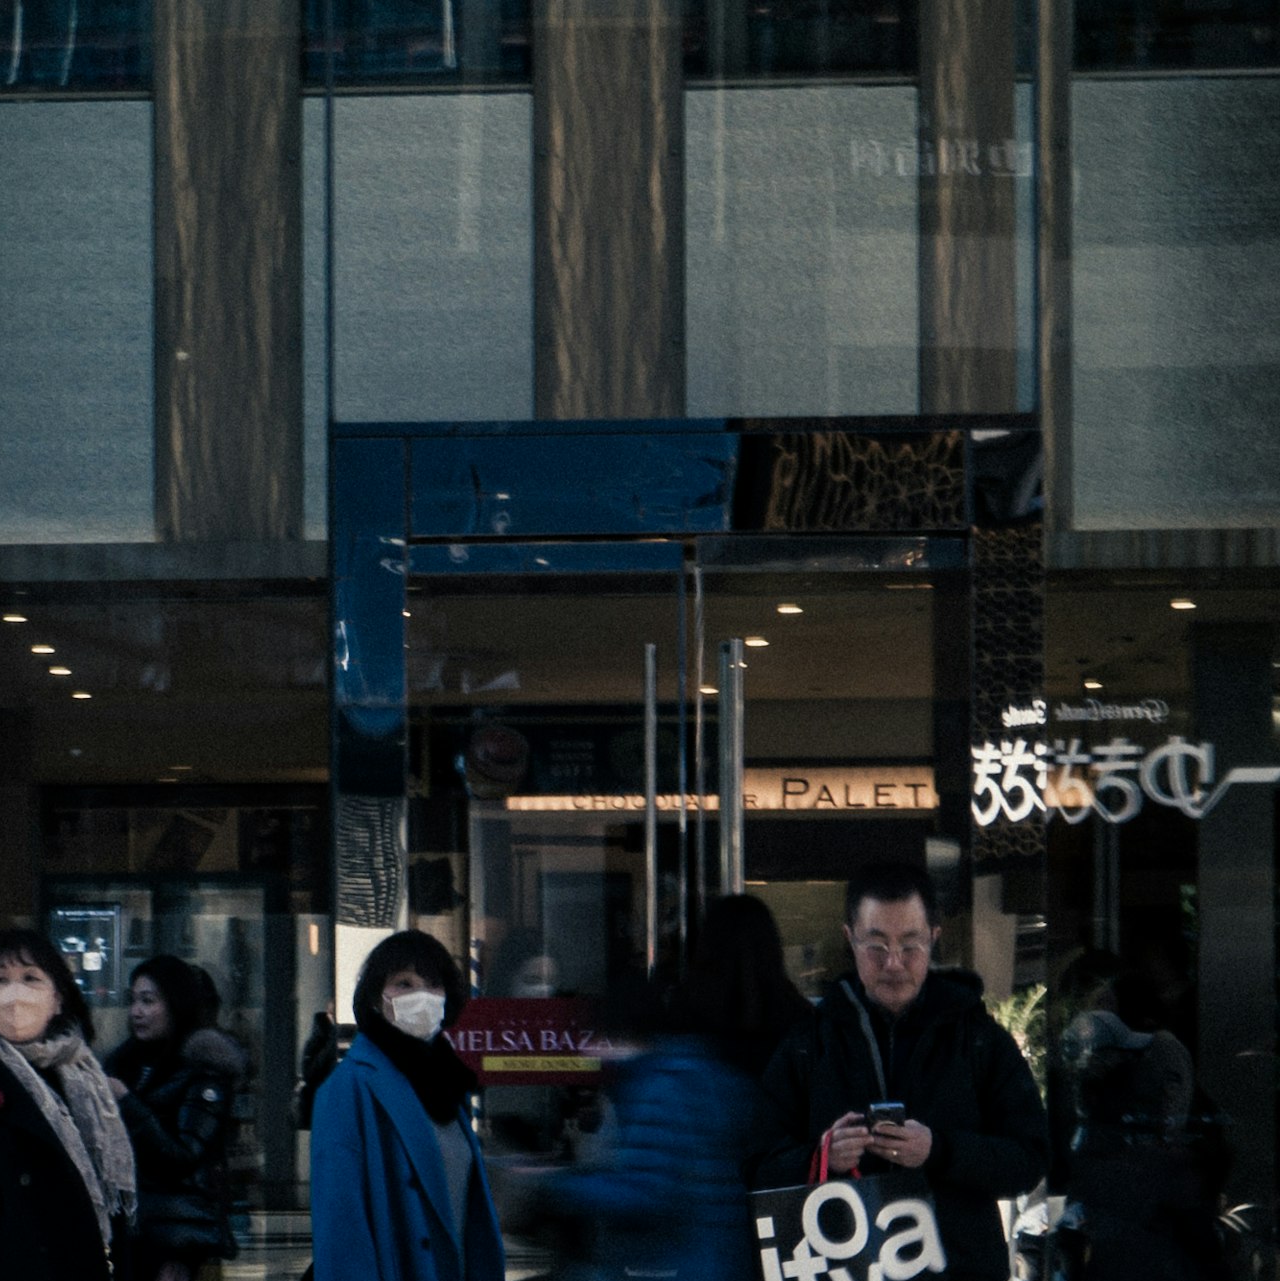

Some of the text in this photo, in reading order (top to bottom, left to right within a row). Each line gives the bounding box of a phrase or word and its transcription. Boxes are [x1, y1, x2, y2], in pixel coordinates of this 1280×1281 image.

[781, 777, 928, 809] PALET
[442, 1029, 613, 1051] MELSA BAZA
